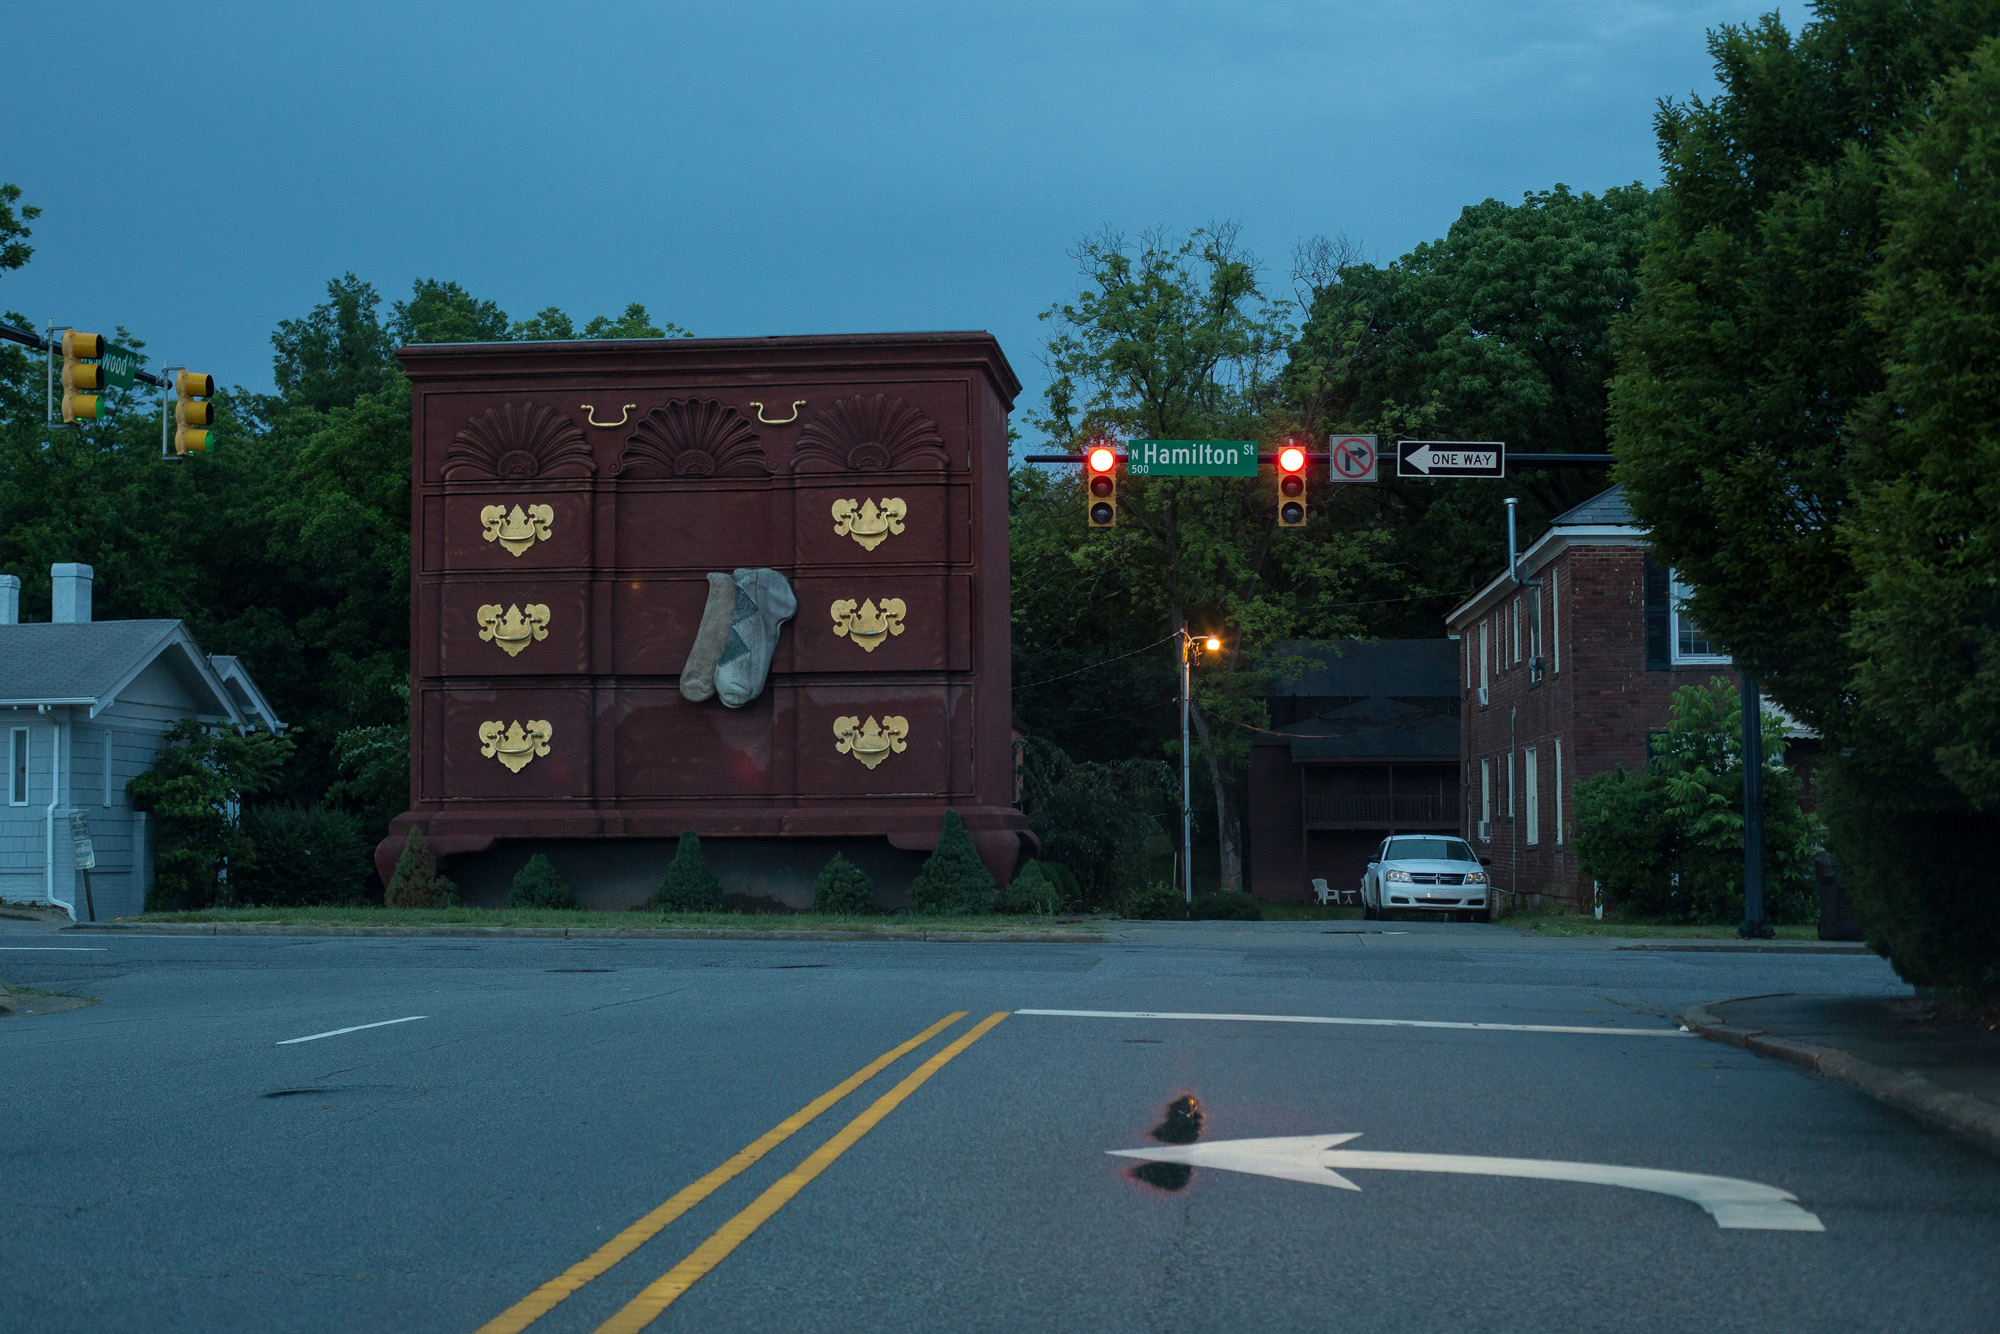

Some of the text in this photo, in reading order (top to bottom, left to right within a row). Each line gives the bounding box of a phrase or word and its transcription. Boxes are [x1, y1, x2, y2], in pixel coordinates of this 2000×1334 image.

[1132, 444, 1254, 464] N Hamilton St
[1432, 454, 1492, 466] ONE WAY
[1132, 464, 1149, 474] 500
